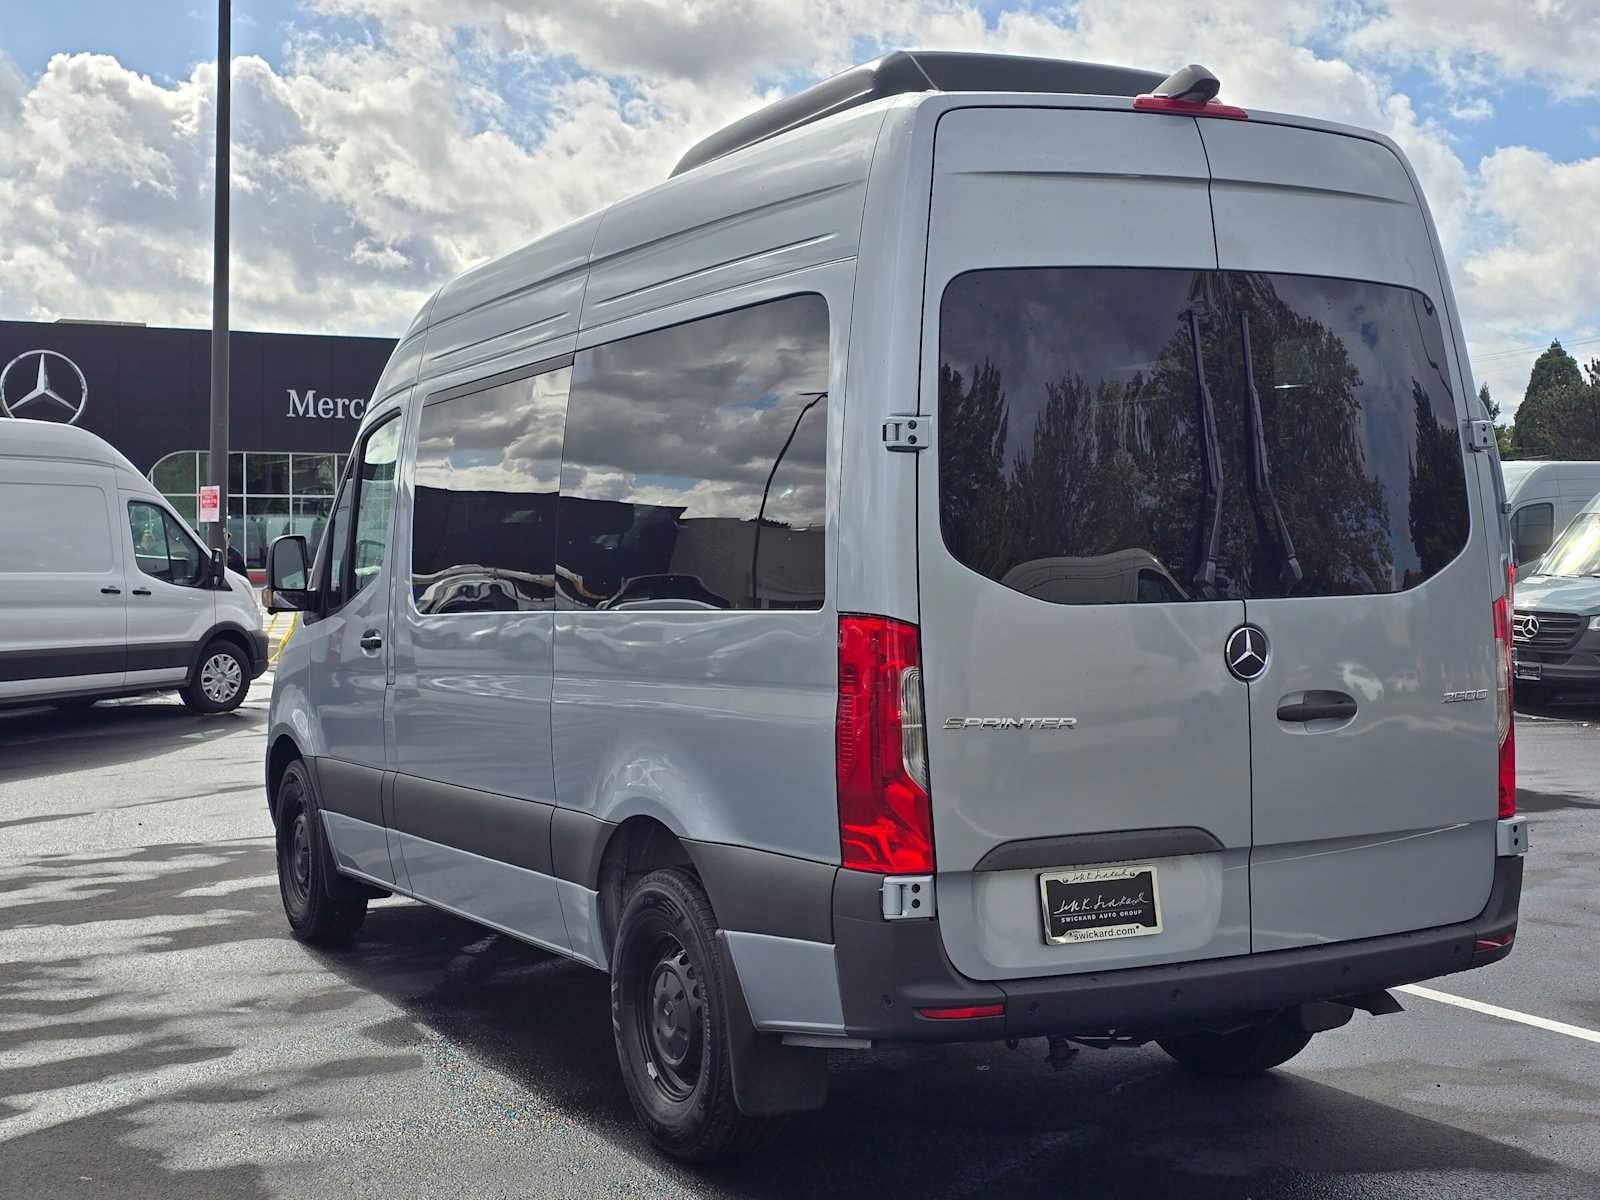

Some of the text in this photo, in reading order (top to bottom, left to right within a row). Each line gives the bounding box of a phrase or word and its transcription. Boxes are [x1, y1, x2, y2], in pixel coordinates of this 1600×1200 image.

[286, 389, 369, 420] Merc
[943, 717, 1077, 729] SPRINTER
[1061, 909, 1143, 924] SWICKARD AUTO GROUP
[1073, 926, 1136, 941] swickard.com
